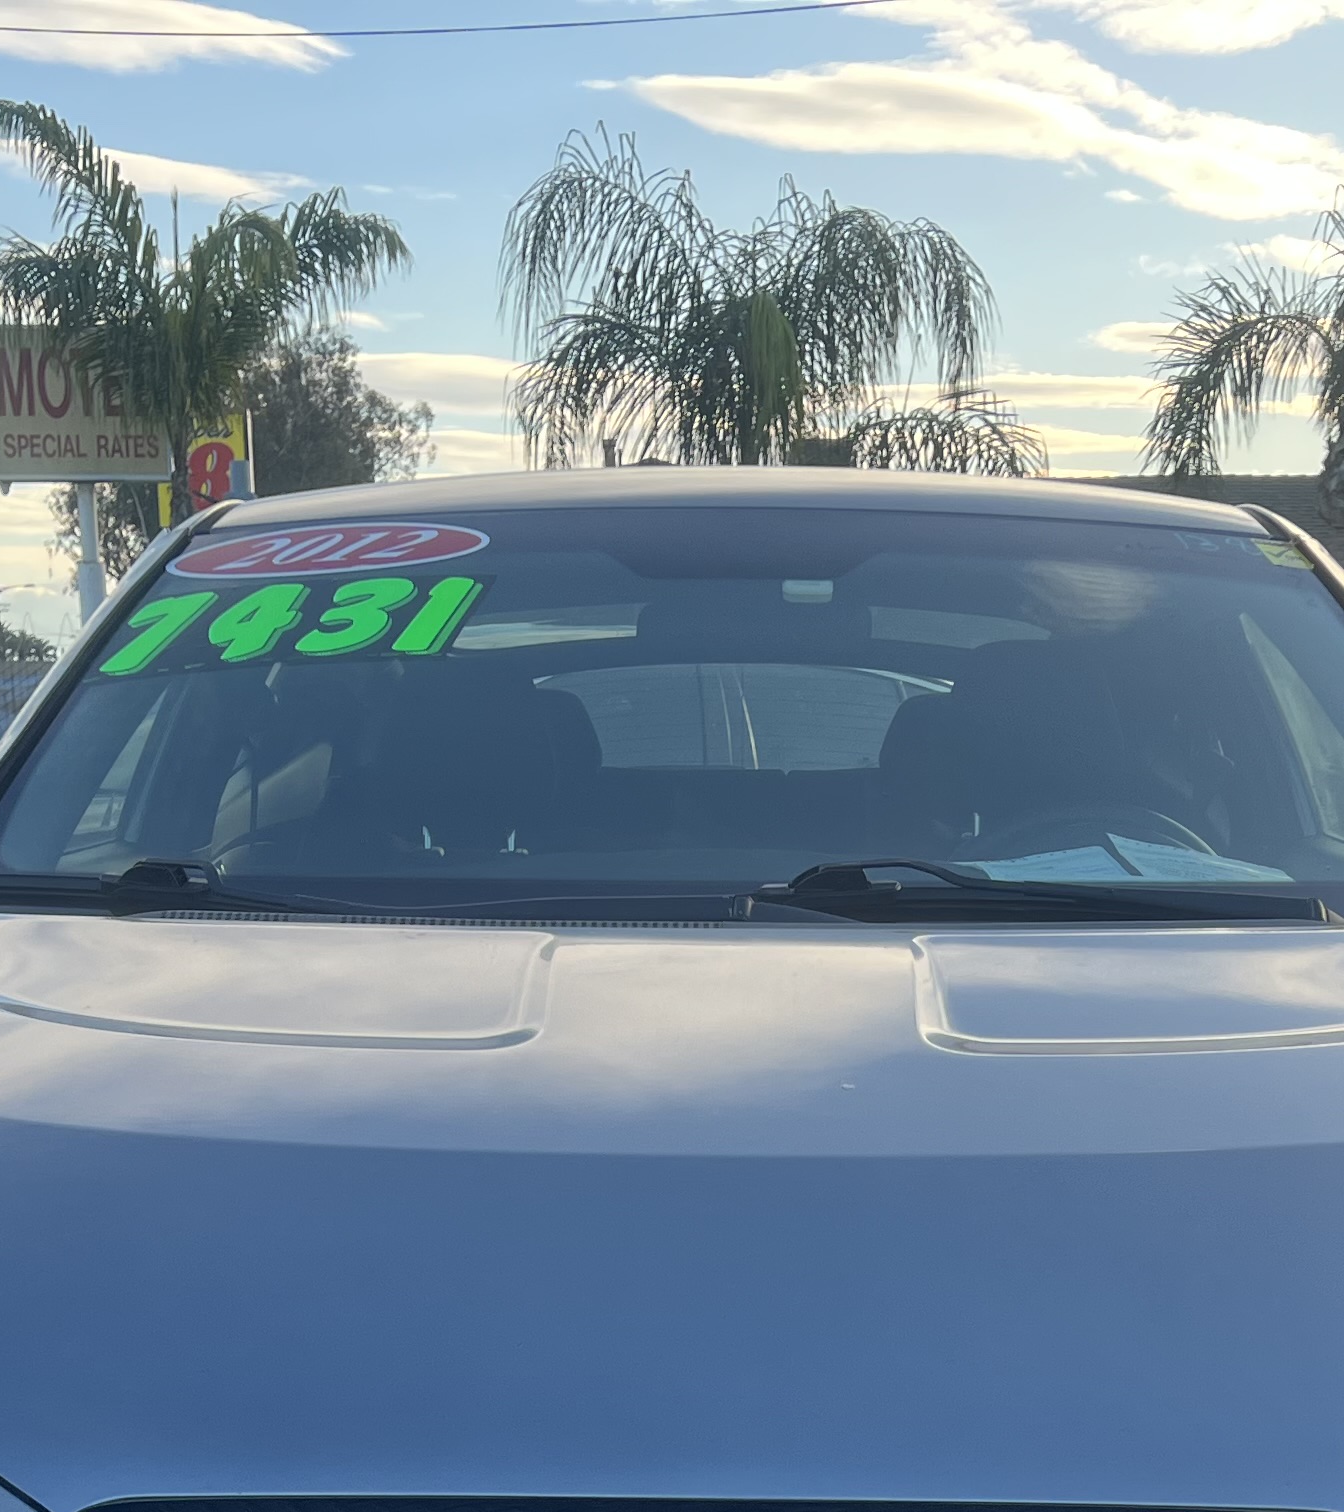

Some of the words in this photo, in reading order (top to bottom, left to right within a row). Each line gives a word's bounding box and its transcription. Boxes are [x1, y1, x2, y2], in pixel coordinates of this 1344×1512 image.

[3, 433, 87, 459] SPECIAL
[97, 434, 160, 459] RATES
[188, 442, 234, 510] 8
[211, 530, 440, 572] 2012
[99, 577, 483, 675] 7431
